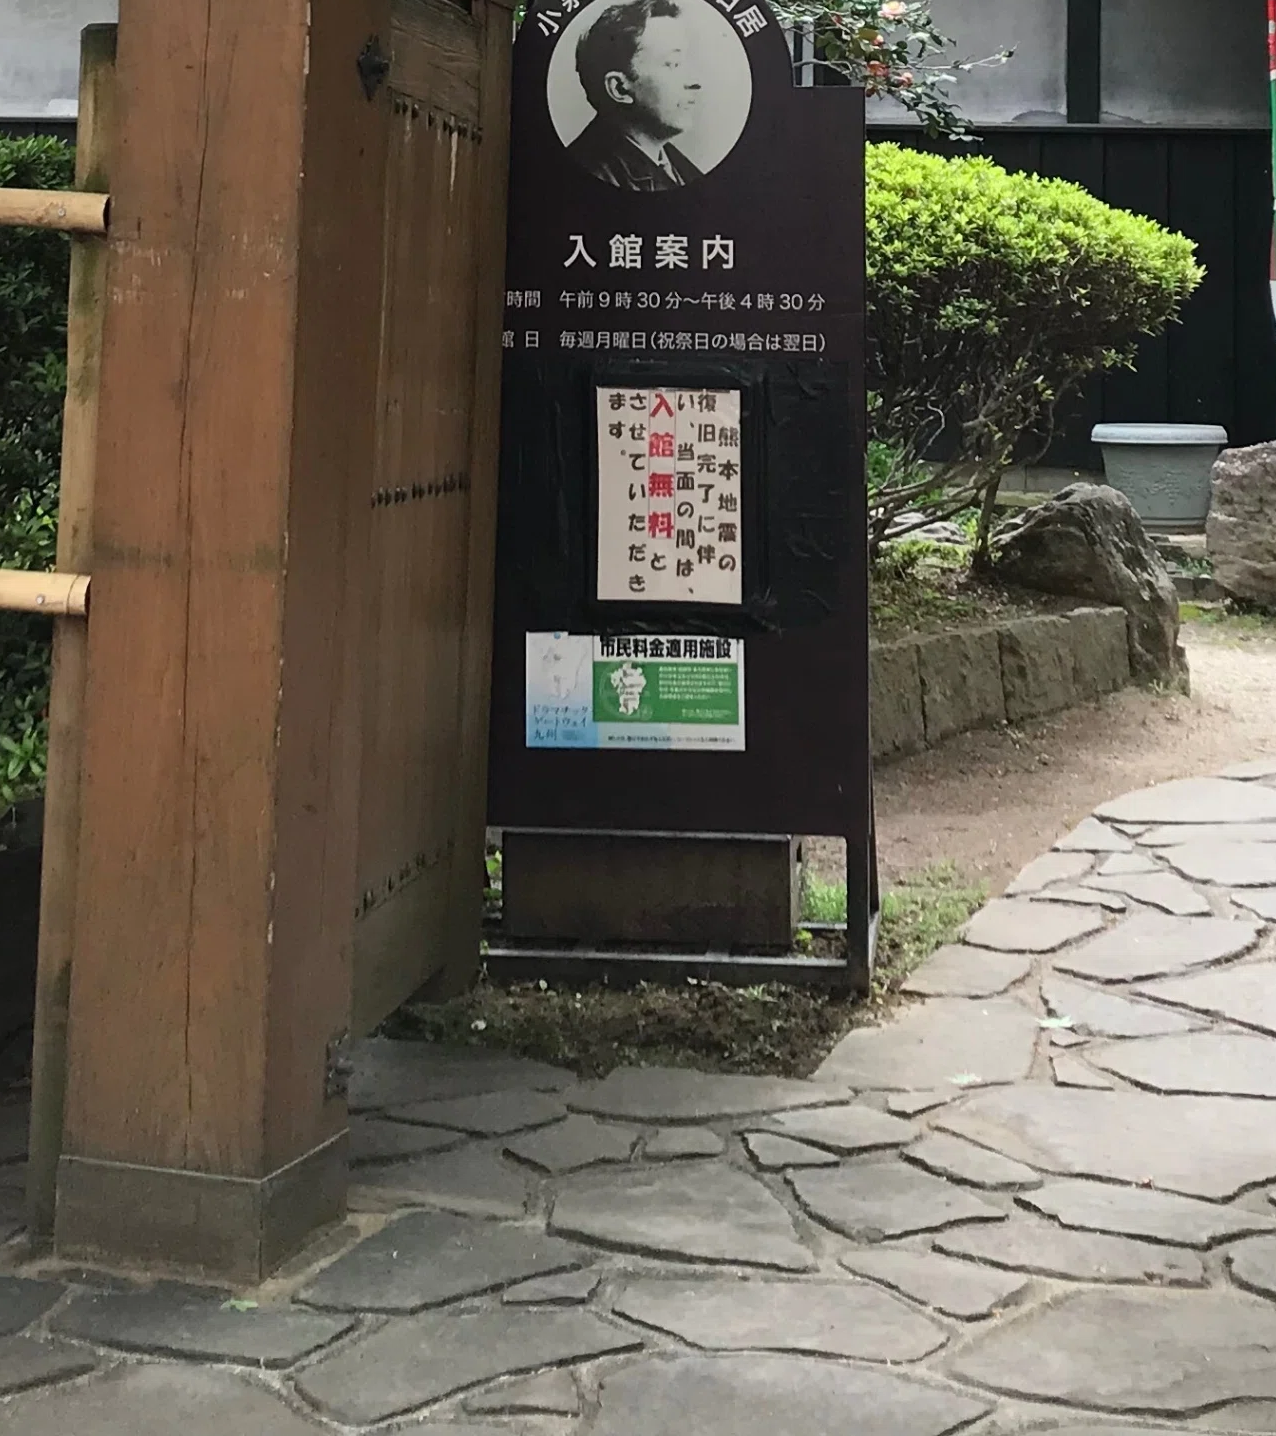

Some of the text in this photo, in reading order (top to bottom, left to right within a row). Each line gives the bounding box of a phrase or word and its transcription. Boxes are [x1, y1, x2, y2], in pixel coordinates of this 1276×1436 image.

[504, 290, 541, 308] 時間
[563, 234, 735, 270] 入館案内
[608, 393, 626, 457] ます。
[628, 393, 647, 593] させていただき
[648, 393, 675, 572] 入館無料と
[676, 394, 696, 594] い、当面の間は、
[697, 393, 717, 565] 復旧完了に伴
[718, 427, 739, 572] 熊本地震の
[600, 636, 732, 659] 市民料金適用施設
